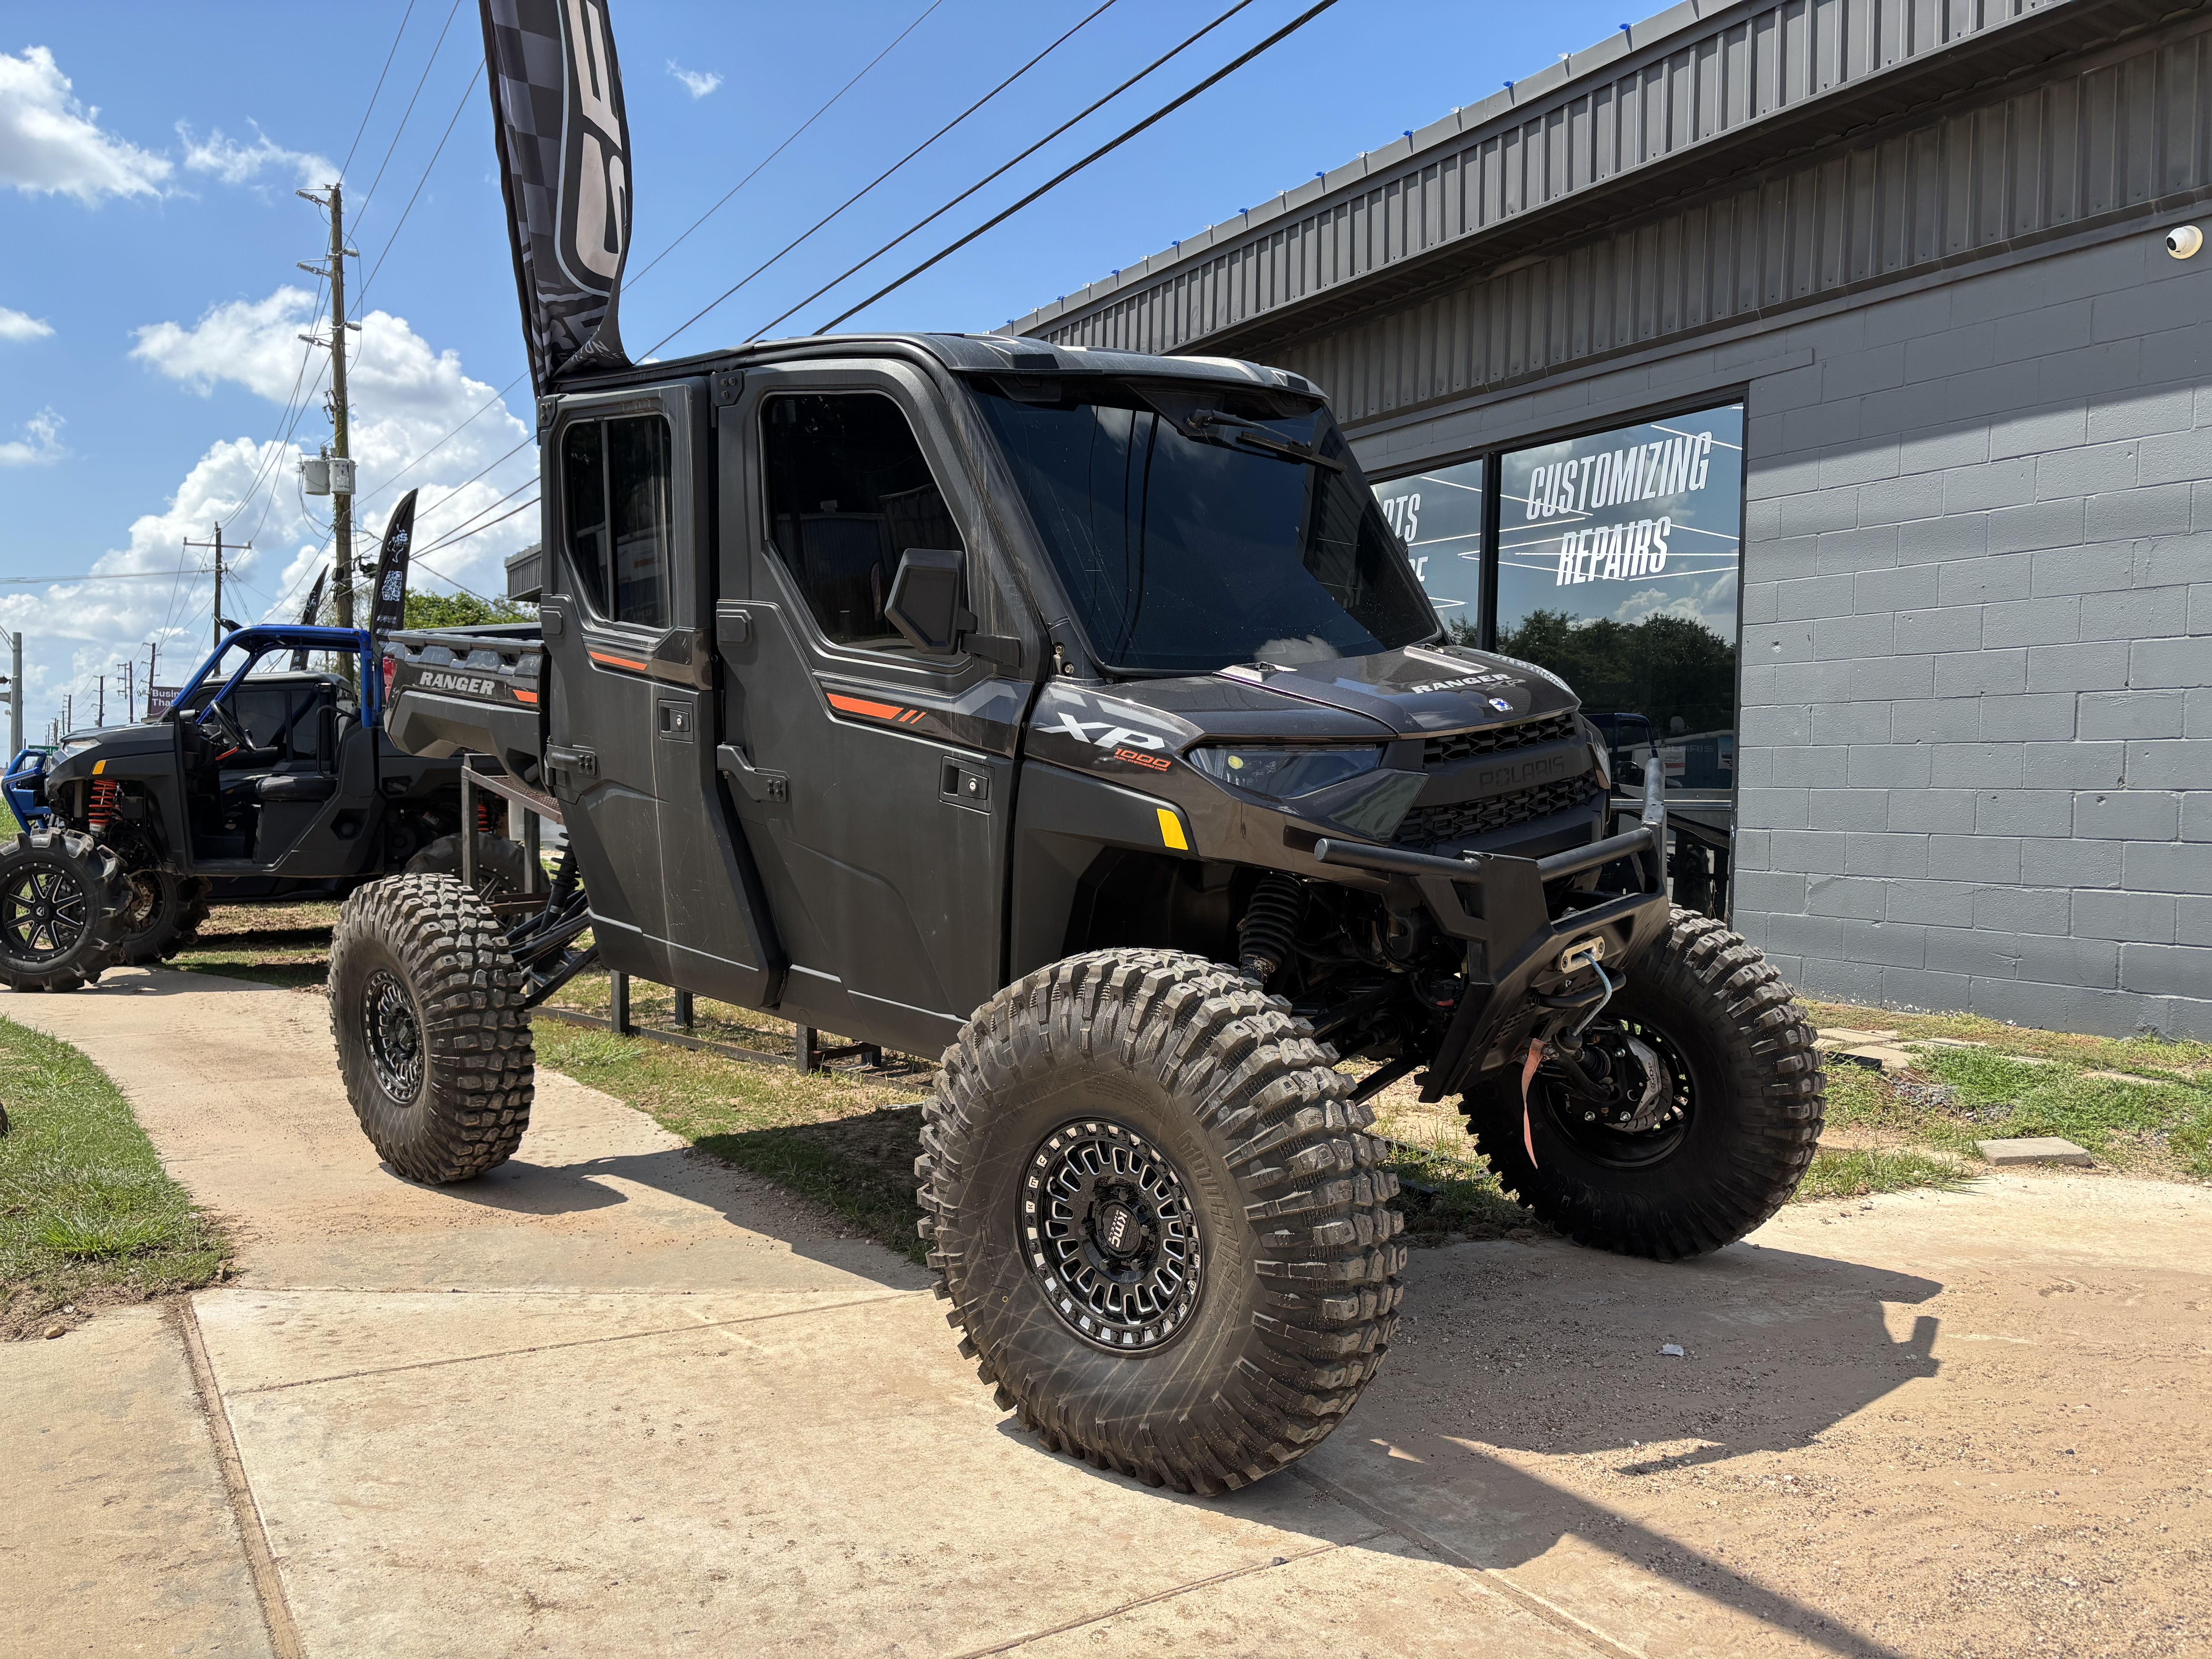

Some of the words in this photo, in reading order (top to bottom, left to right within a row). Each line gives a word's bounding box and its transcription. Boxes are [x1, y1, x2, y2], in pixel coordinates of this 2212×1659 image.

[1526, 431, 1712, 520] CUSTOMIZING
[1556, 516, 1671, 586] REPAIRS
[419, 672, 495, 696] RANGER
[1411, 674, 1512, 694] RANGER
[1035, 712, 1165, 750] XP
[1115, 748, 1171, 768] 1000
[1479, 755, 1565, 791] POLARIS
